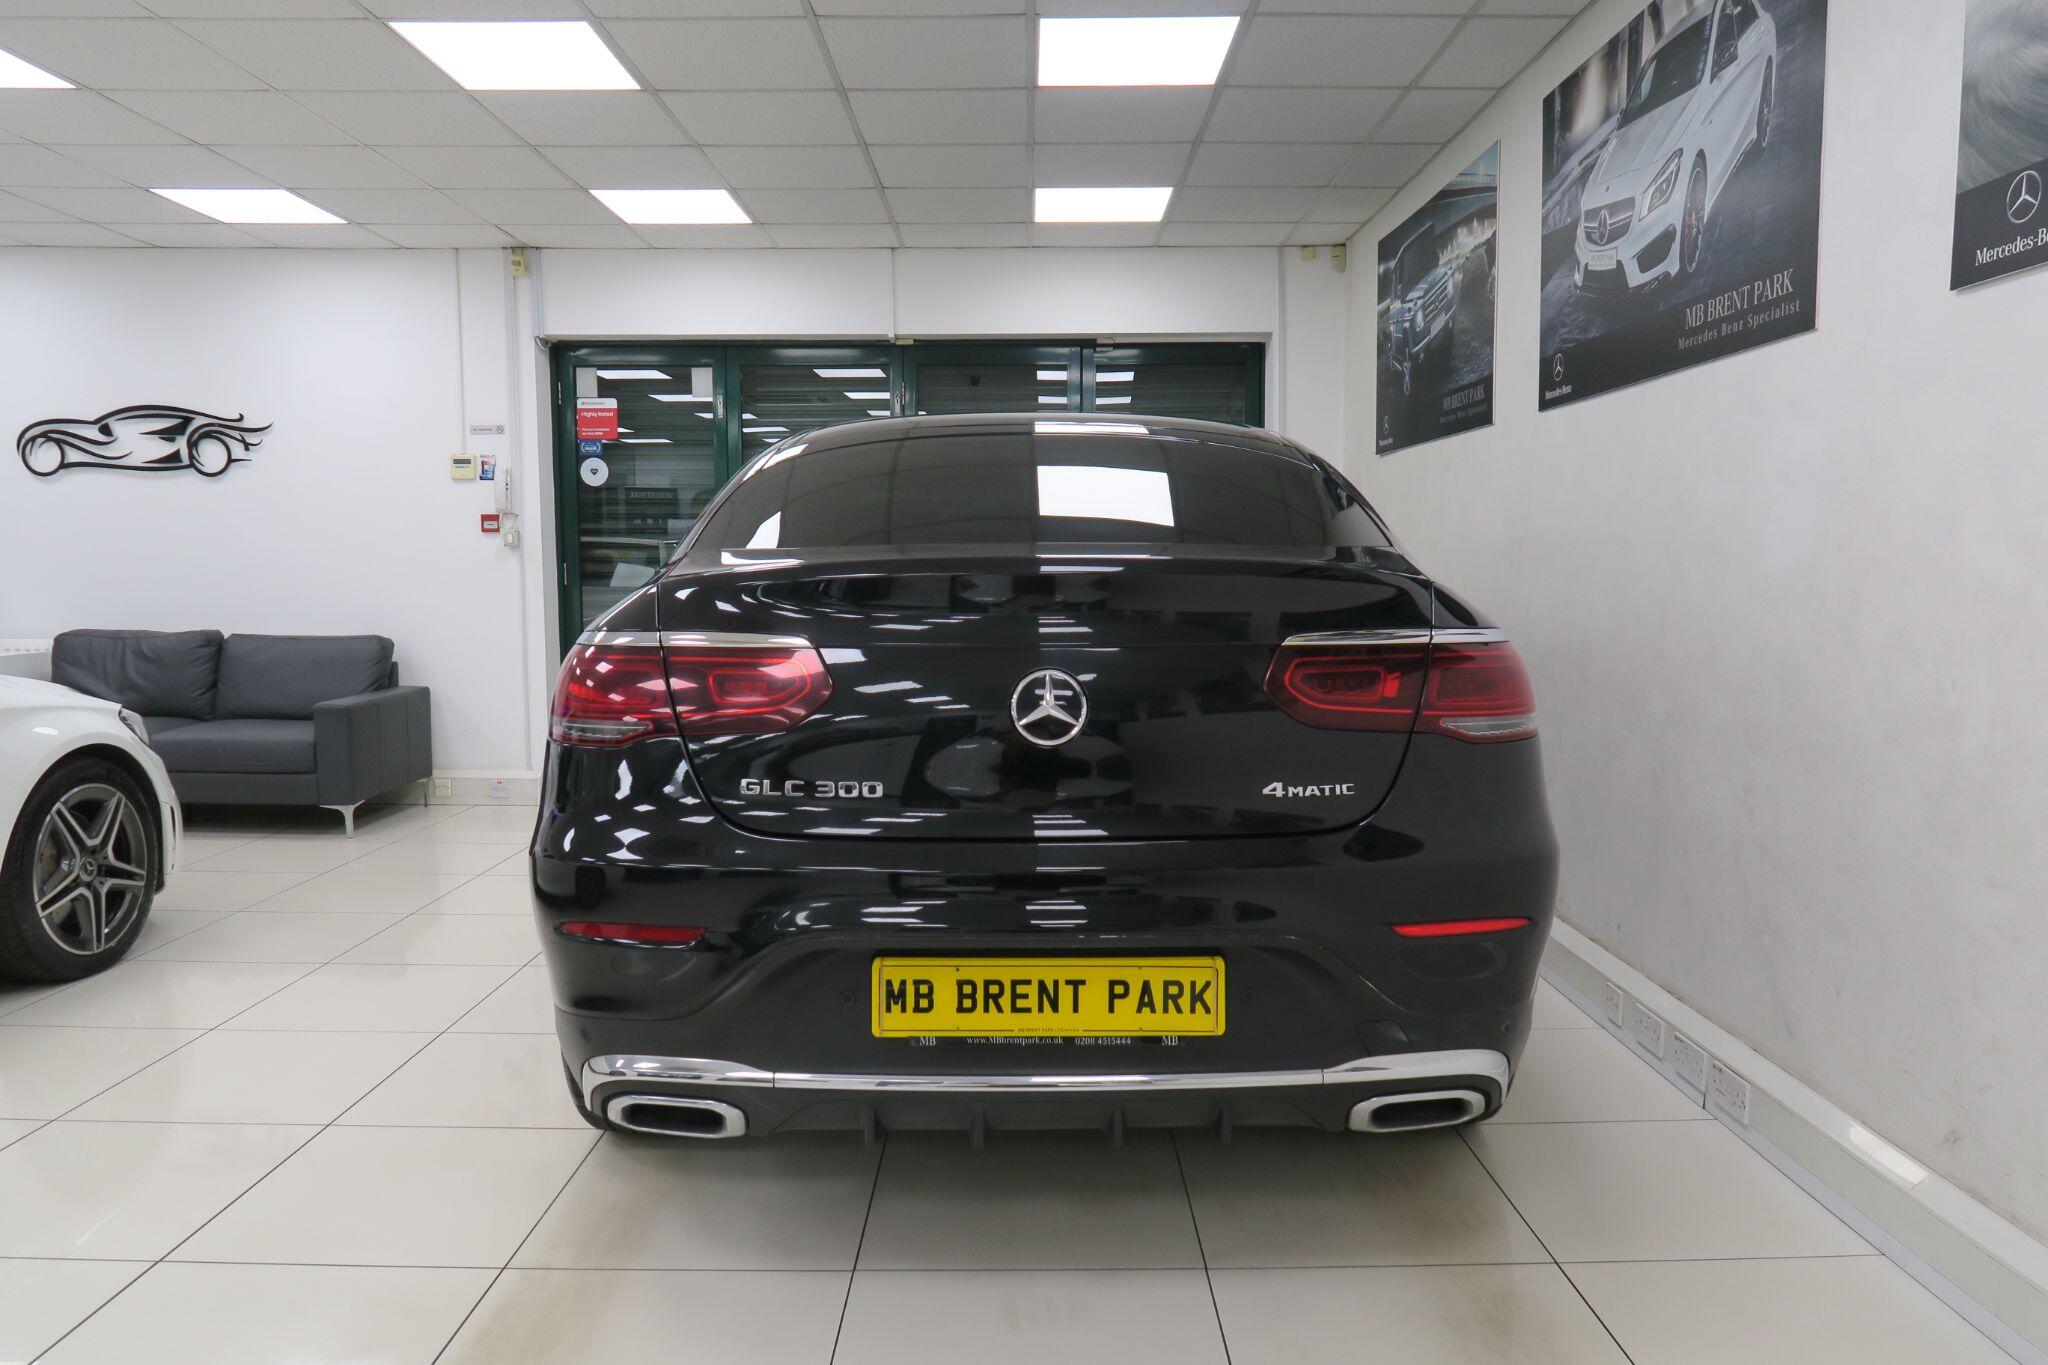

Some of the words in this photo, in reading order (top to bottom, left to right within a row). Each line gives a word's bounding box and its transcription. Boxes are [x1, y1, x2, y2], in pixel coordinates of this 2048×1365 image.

[1975, 227, 2048, 266] Mercedes-B
[1684, 304, 1704, 330] MB
[1707, 285, 1750, 322] BRENT
[1753, 268, 1794, 306] PARK
[1678, 328, 1718, 351] Mercedes
[1721, 320, 1744, 336] Benz
[1747, 300, 1800, 330] Specialist
[740, 778, 805, 797] GLC
[814, 780, 884, 798] 300
[1262, 781, 1355, 798] 4MATIC
[884, 978, 935, 1014] MB
[956, 978, 1087, 1014] BRENT
[1107, 979, 1213, 1015] PARK
[919, 1036, 936, 1046] MB
[1075, 1036, 1096, 1046] 0208
[1161, 1035, 1179, 1046] MB
